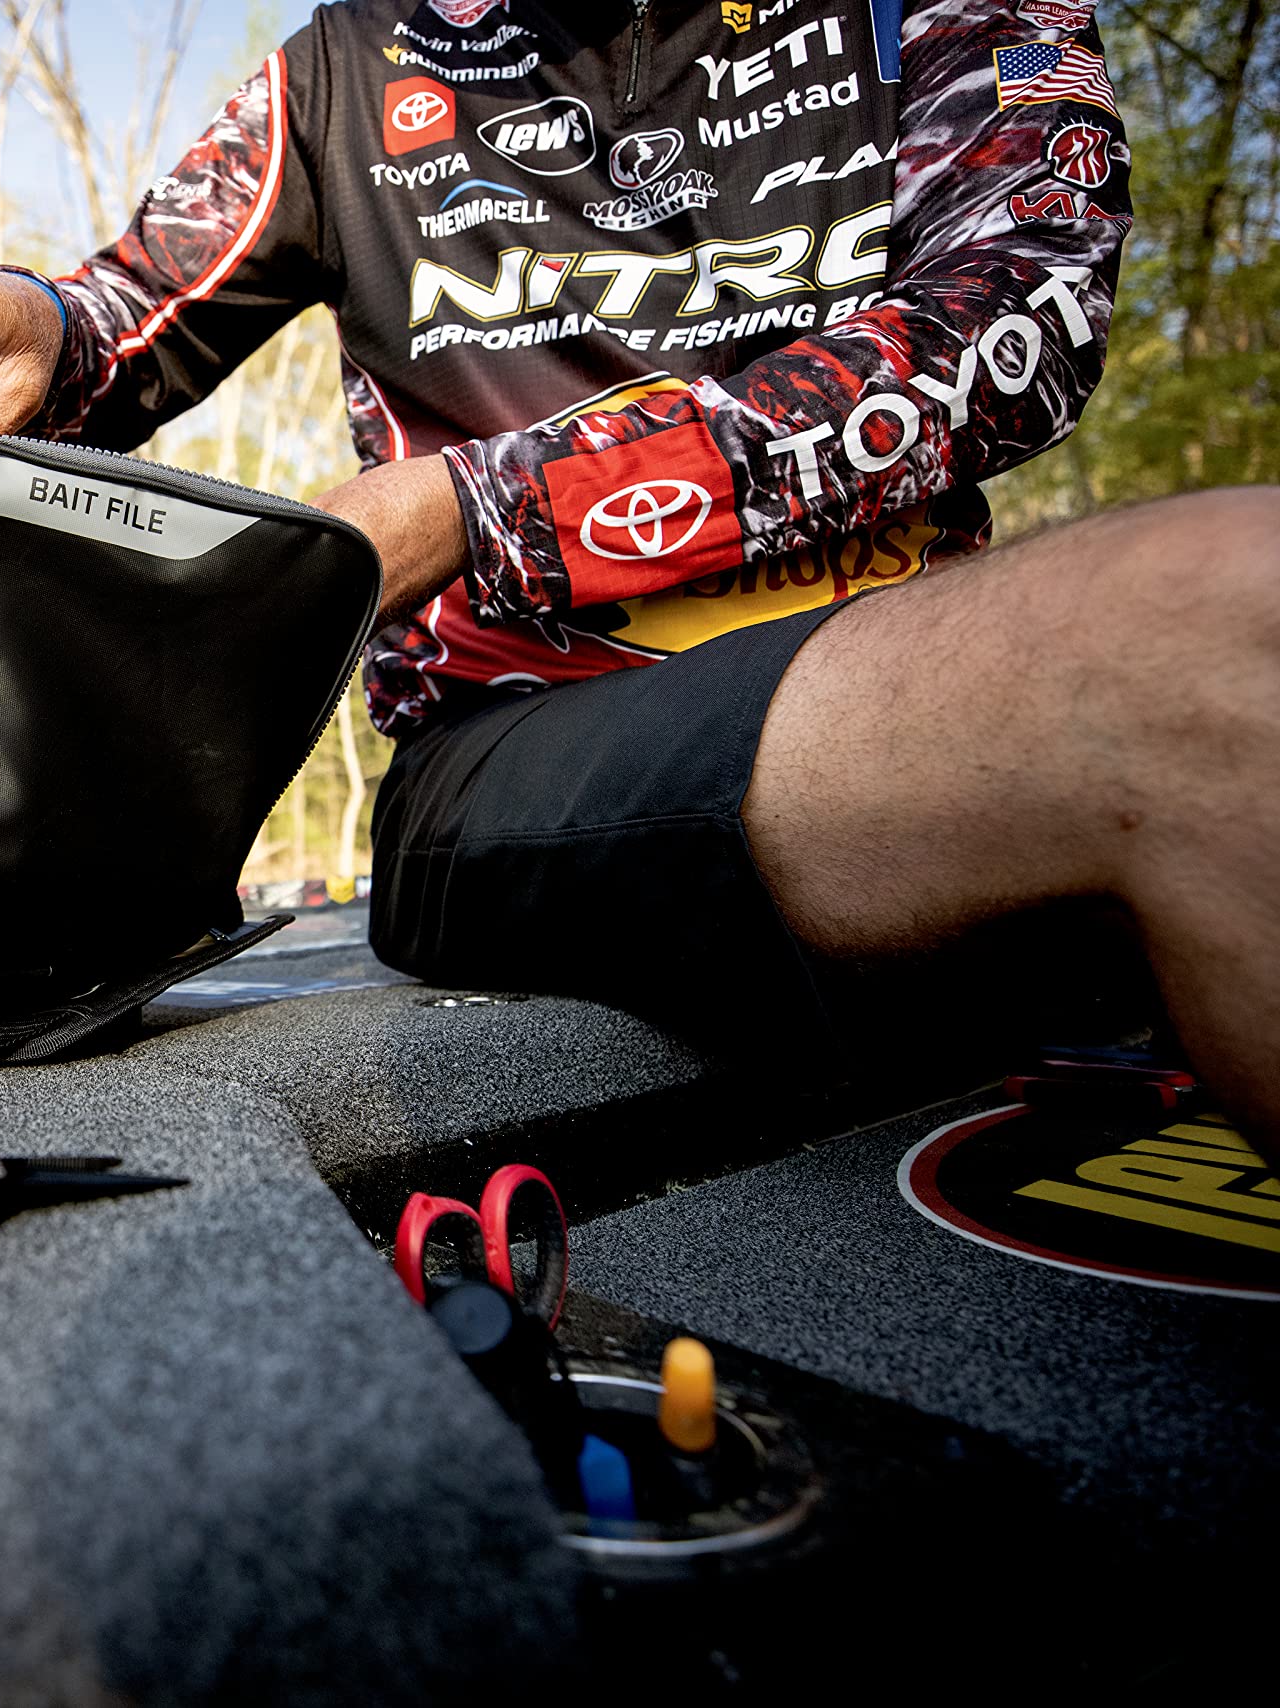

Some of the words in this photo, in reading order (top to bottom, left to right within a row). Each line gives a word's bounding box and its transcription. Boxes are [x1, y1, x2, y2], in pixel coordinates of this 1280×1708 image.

[393, 22, 453, 53] Kevin
[460, 24, 539, 53] VanDa
[695, 16, 843, 101] YETI
[698, 72, 860, 148] Mustad
[370, 152, 471, 190] TOYOTA
[583, 181, 663, 220] MOSSY
[661, 168, 714, 200] OAK
[750, 134, 900, 205] PLA
[418, 198, 550, 239] THERMACELL
[659, 303, 817, 353] FISHING
[29, 476, 100, 517] BAIT
[105, 496, 168, 536] FILE
